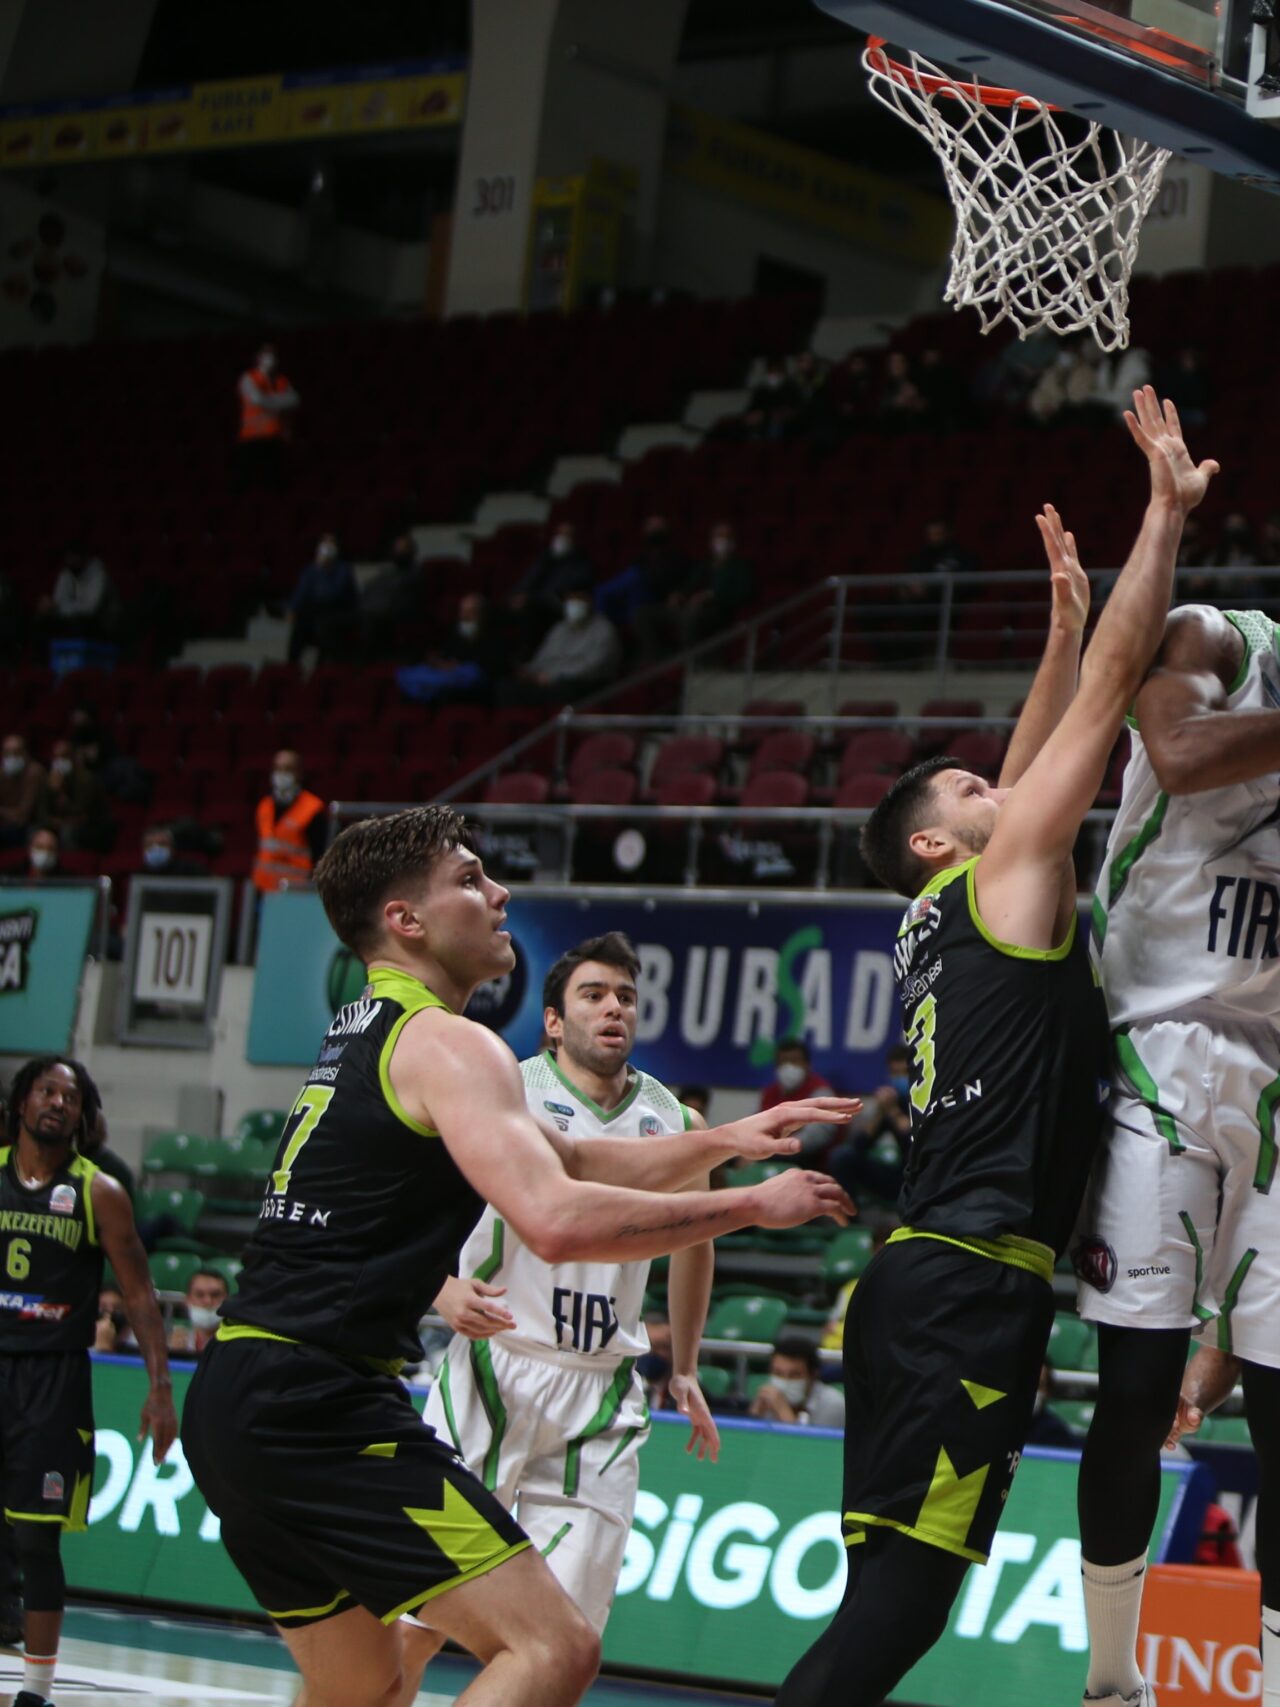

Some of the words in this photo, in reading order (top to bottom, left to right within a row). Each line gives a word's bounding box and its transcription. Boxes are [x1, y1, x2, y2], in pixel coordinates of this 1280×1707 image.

[474, 178, 515, 216] 301
[153, 926, 198, 987] 101
[633, 926, 895, 1066] BURSAD
[0, 1210, 83, 1253] KEZEFENDİ
[260, 1198, 332, 1228] GREEN
[6, 1237, 32, 1281] 6
[1127, 1265, 1171, 1279] sportive
[1142, 1632, 1264, 1700] ING
